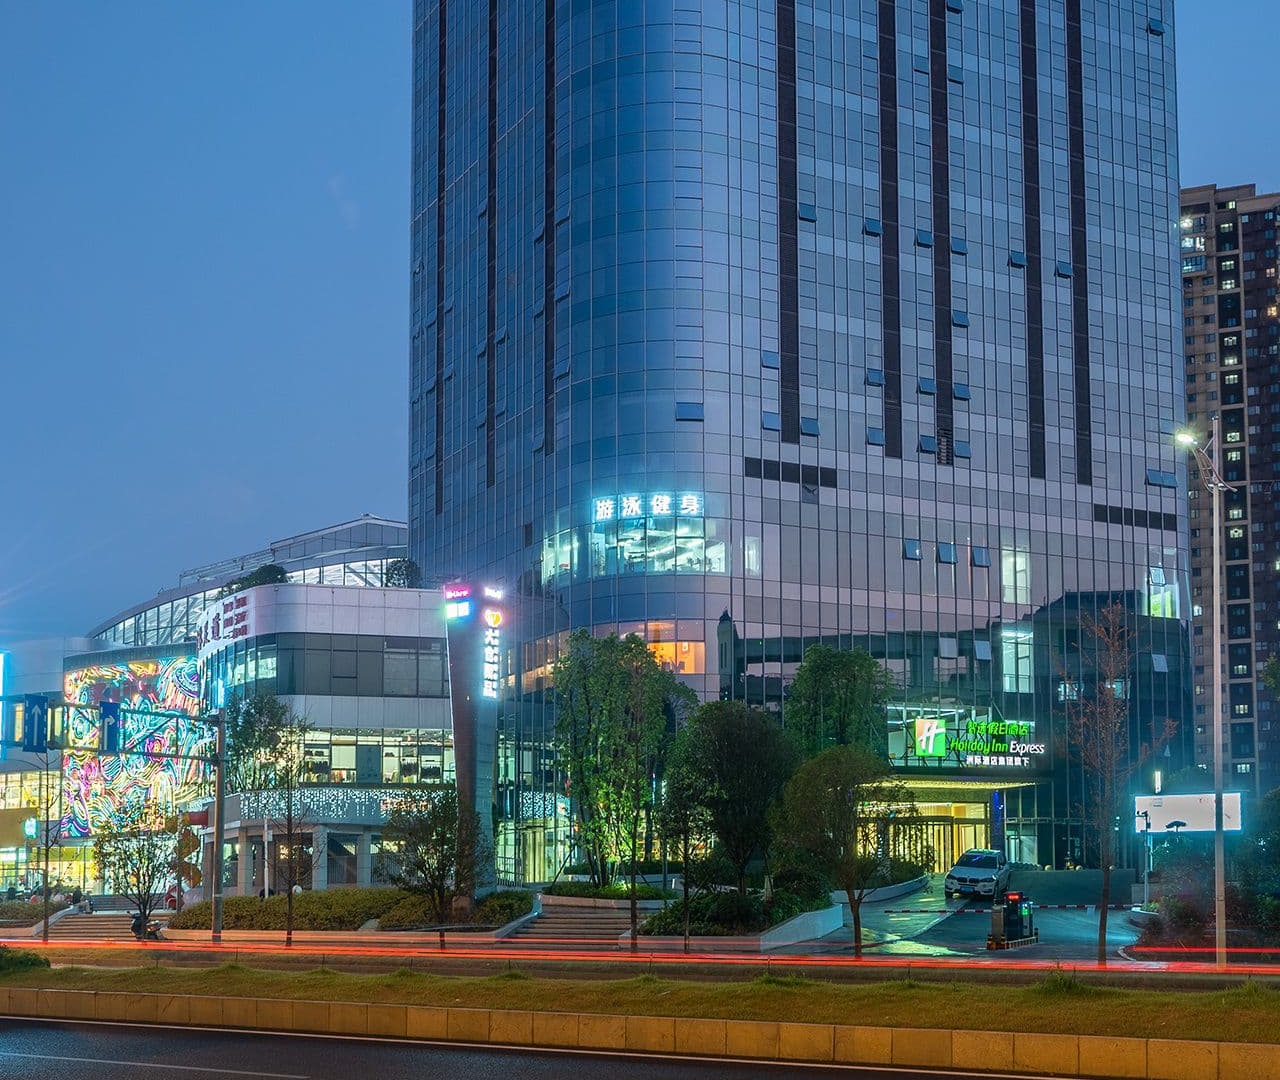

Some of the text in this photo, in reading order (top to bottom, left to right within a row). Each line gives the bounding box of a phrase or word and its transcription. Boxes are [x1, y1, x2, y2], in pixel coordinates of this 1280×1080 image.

[596, 493, 700, 520] 游泳健身
[967, 720, 1029, 735] 智选假日酒店
[950, 738, 1045, 756] Holiday Inn Express
